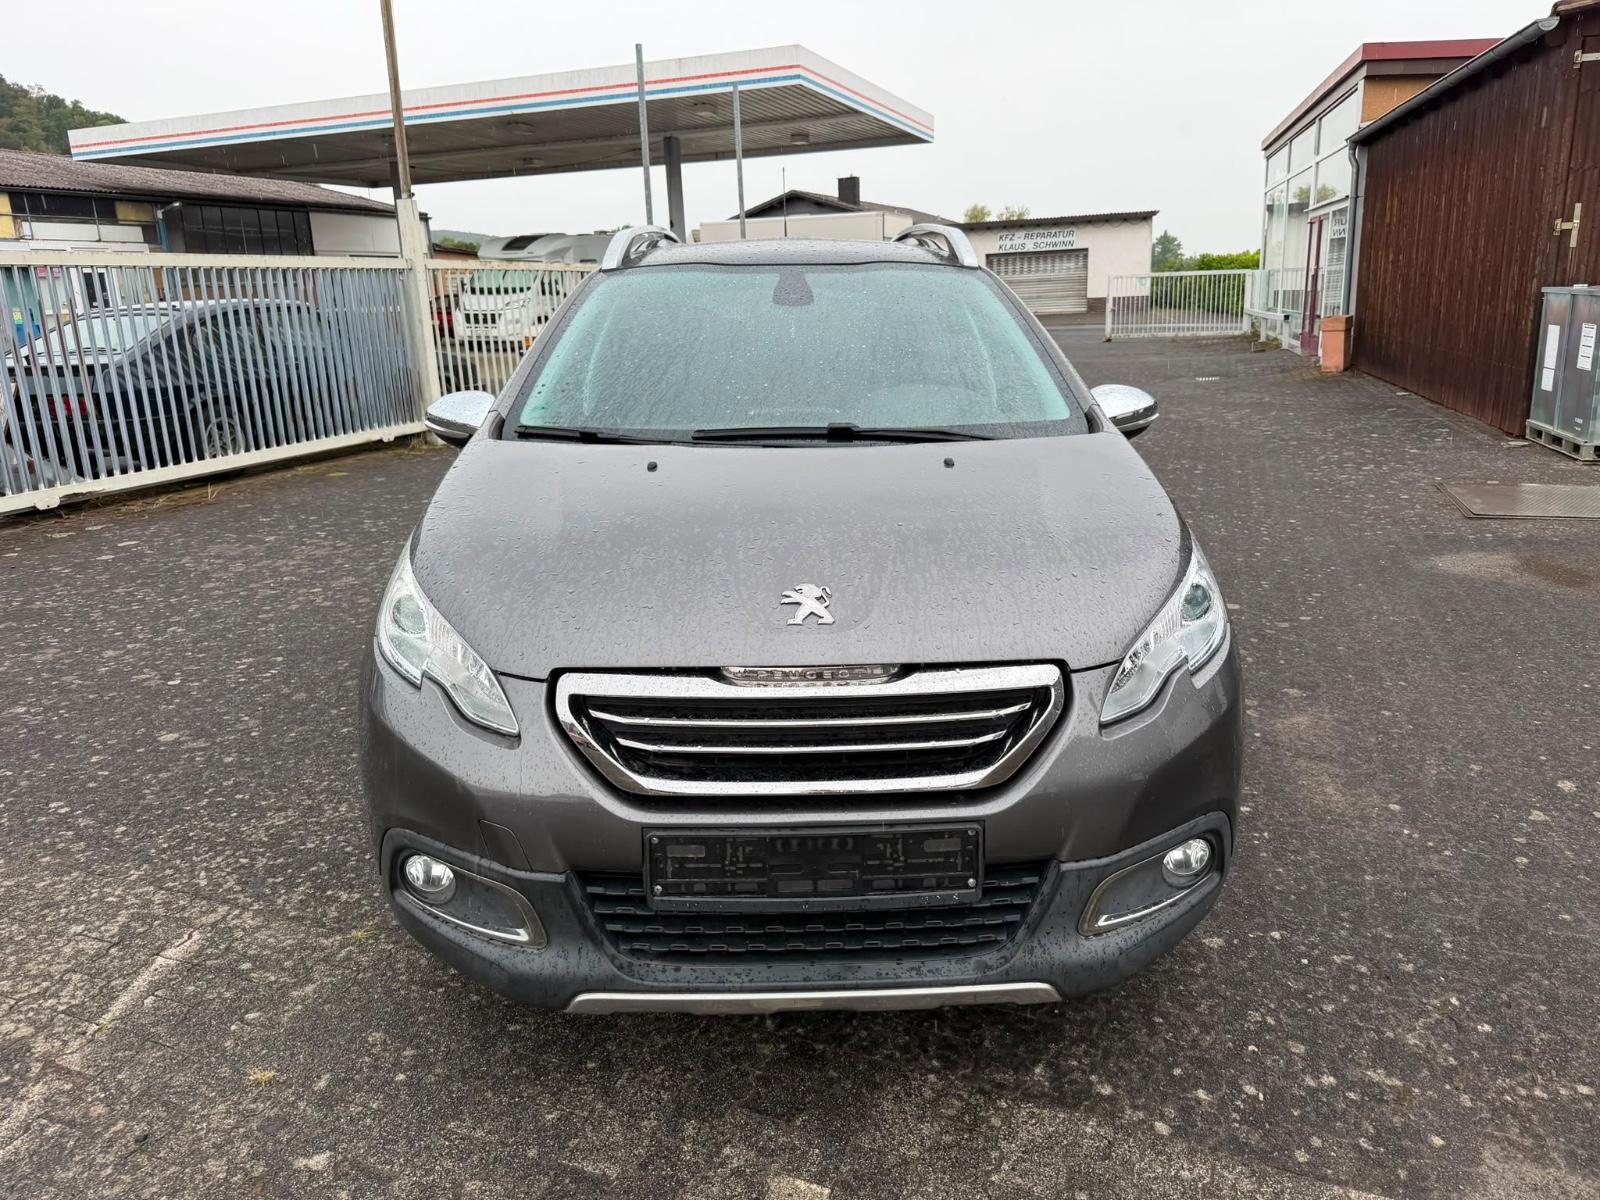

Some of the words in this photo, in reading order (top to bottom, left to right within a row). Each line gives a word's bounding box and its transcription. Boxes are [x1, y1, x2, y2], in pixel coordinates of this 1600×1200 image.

[999, 233, 1016, 242] KFZ
[1023, 230, 1075, 241] REPARATUR
[998, 243, 1026, 252] KLAUS
[1032, 240, 1074, 250] SCHWINN
